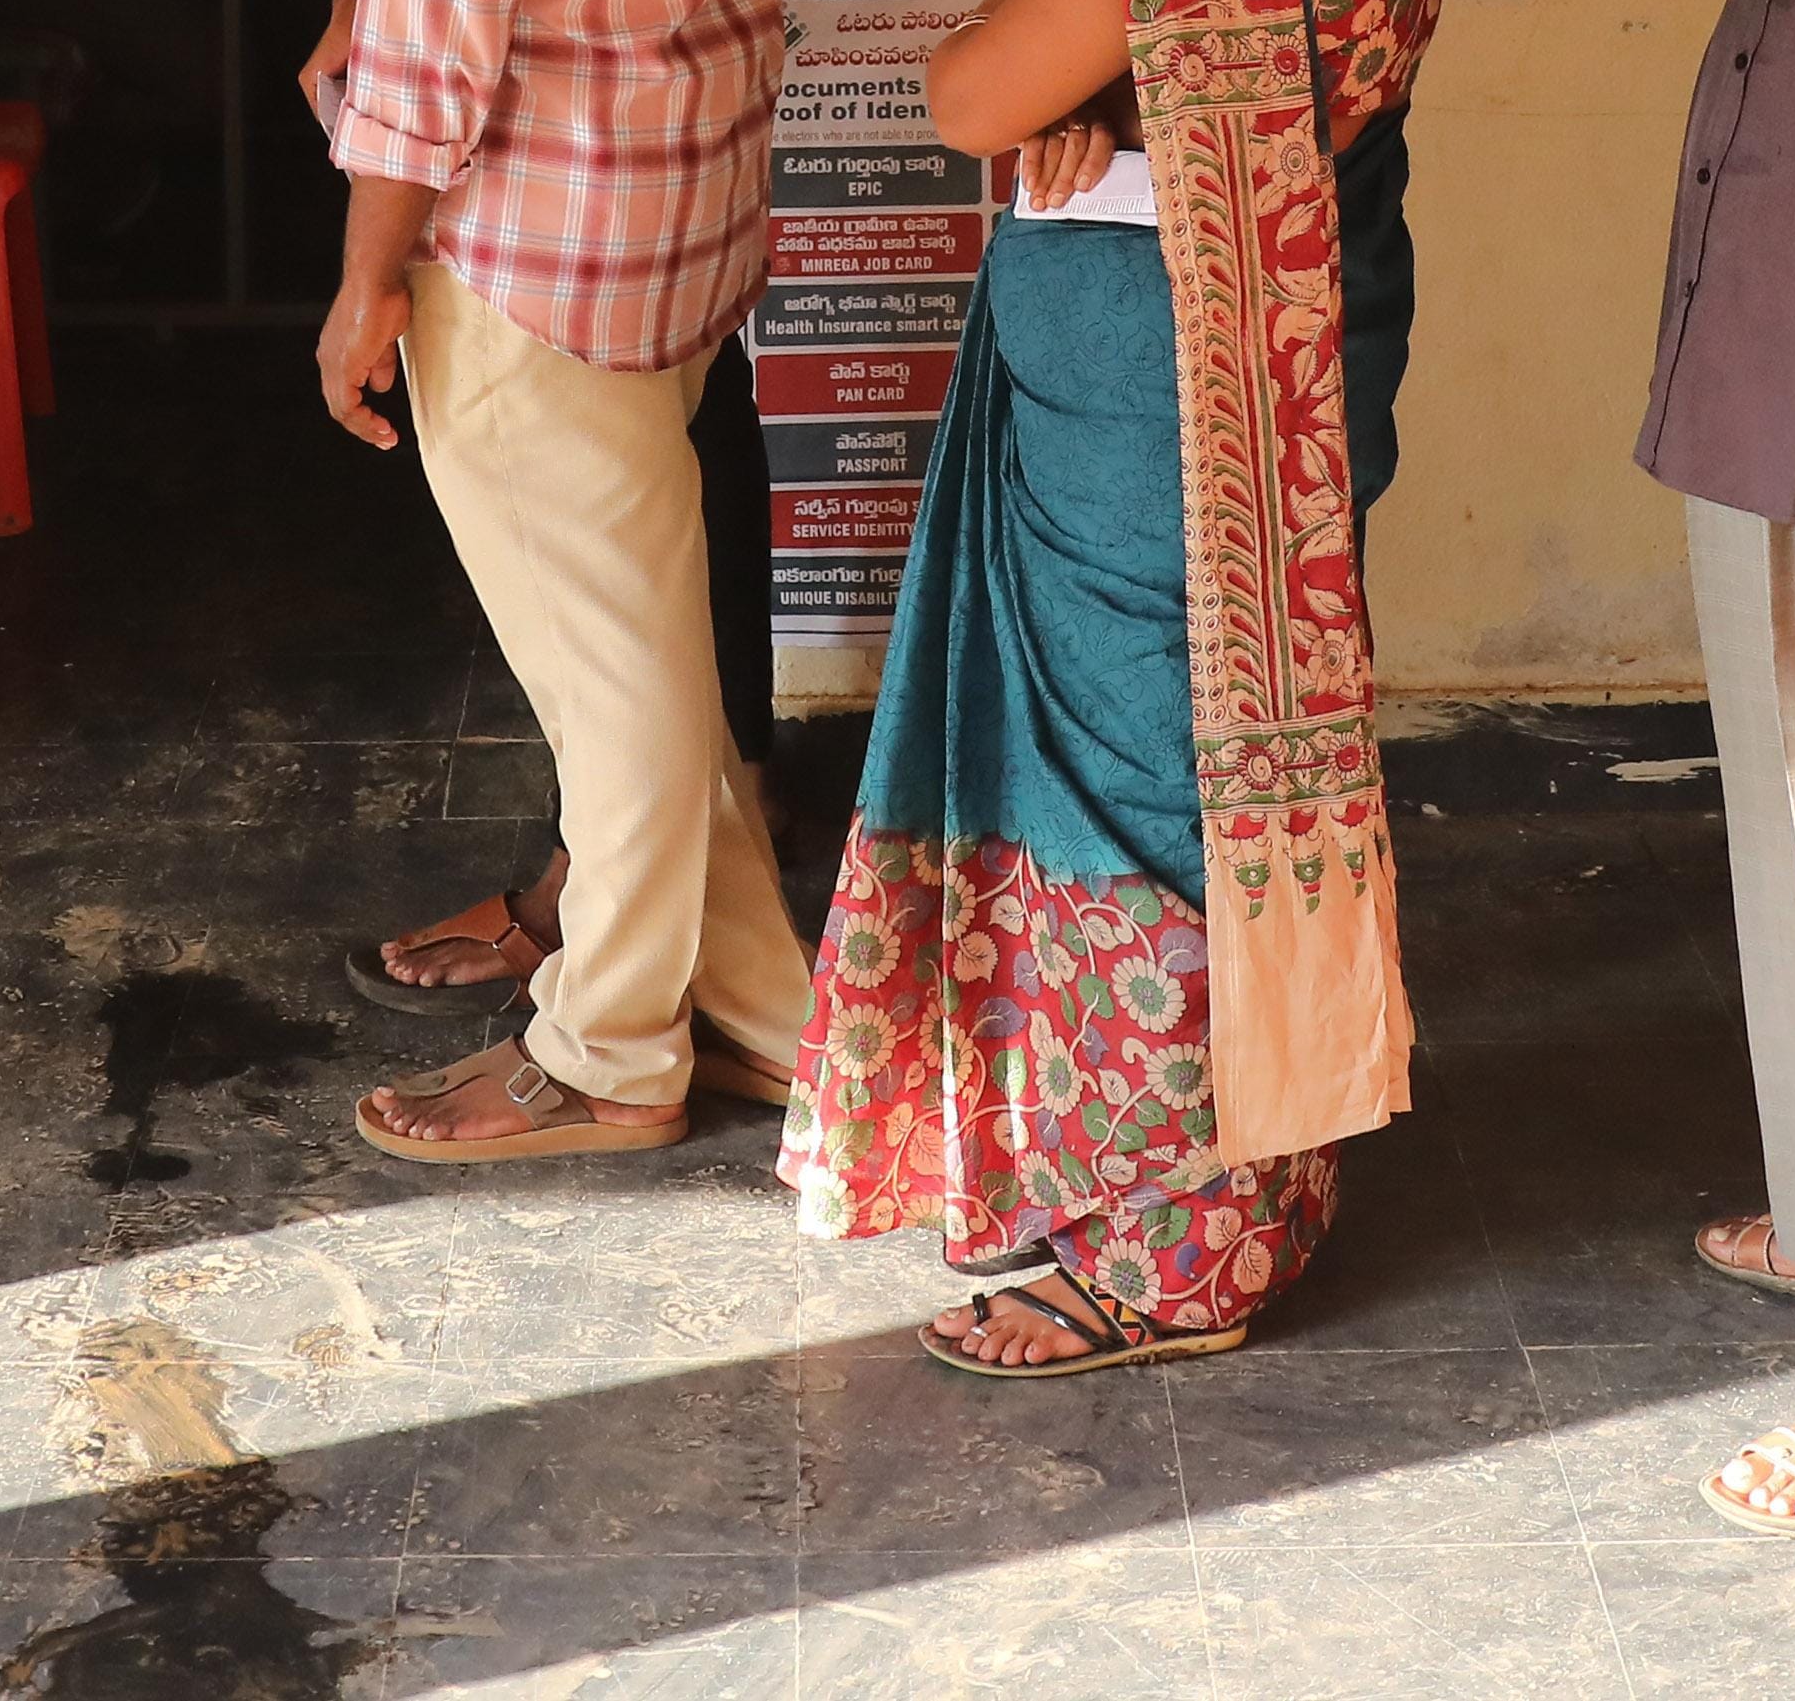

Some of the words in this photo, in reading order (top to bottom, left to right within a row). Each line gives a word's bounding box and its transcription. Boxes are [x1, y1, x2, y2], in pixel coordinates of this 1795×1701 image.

[832, 101, 857, 120] of
[849, 182, 883, 196] EPIC
[801, 258, 860, 273] MNREGA
[863, 258, 890, 271] JOB
[895, 256, 932, 270] CARD
[766, 319, 814, 336] Health
[818, 318, 892, 334] Insurance
[897, 317, 938, 332] smart
[837, 388, 864, 402] PAN
[868, 387, 905, 400] CARD
[837, 458, 908, 474] PASSPORT
[792, 523, 851, 538] SERVICE
[780, 591, 832, 605] UNIQUE
